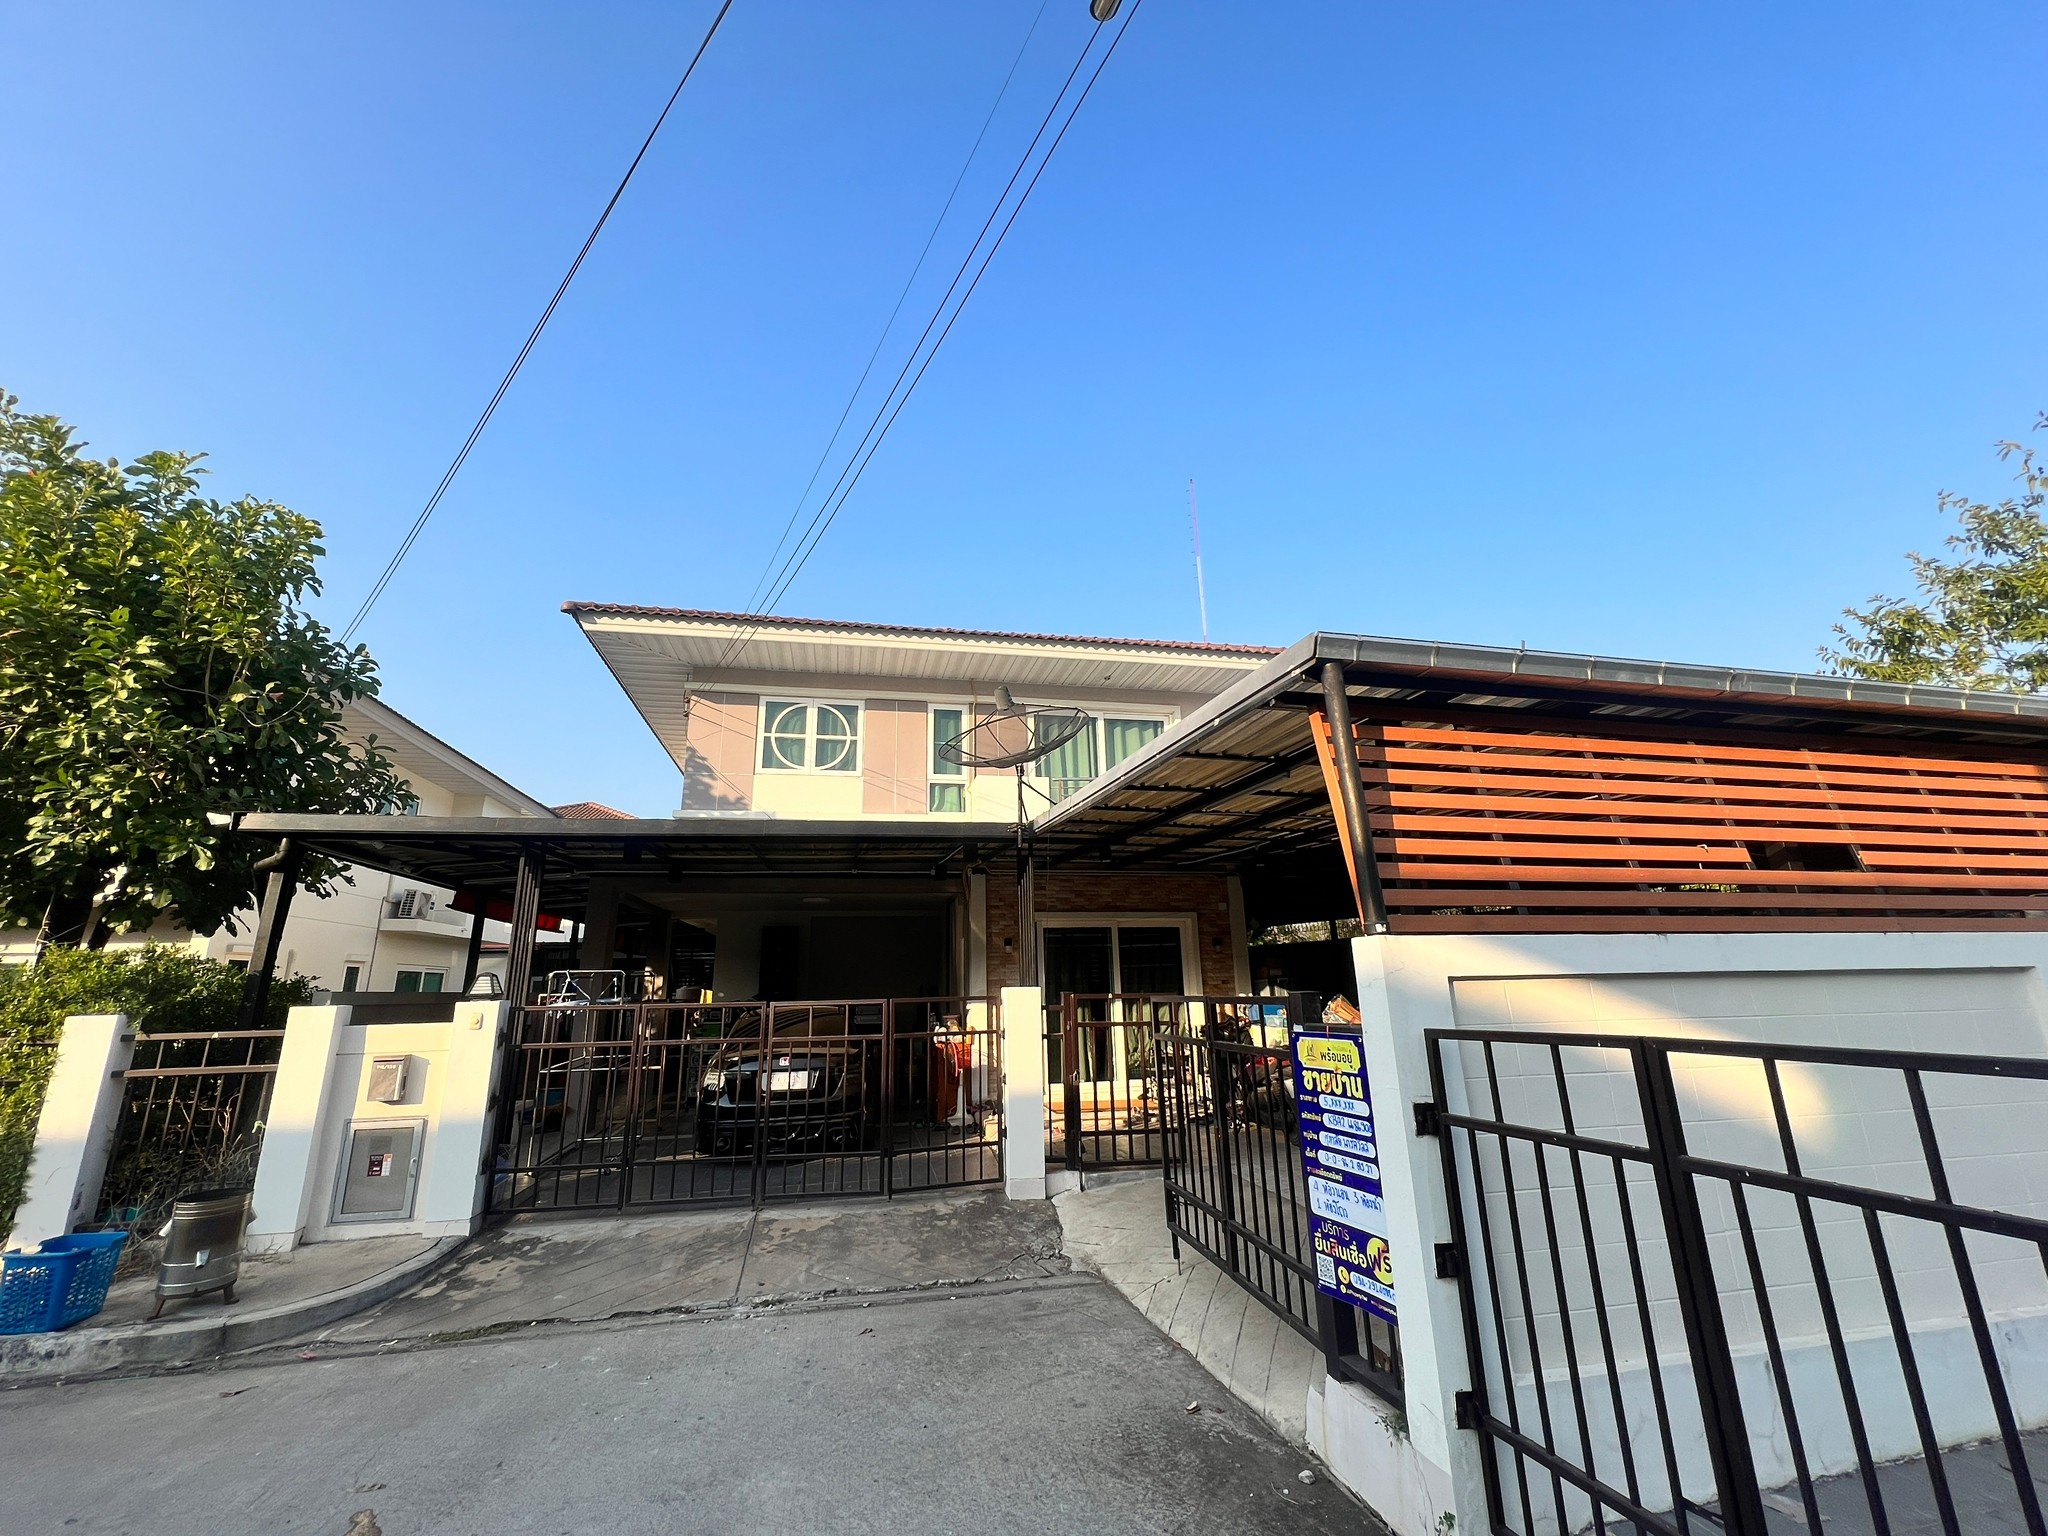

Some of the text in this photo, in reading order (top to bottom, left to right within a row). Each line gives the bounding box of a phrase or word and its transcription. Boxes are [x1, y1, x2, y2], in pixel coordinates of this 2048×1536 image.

[1320, 1046, 1353, 1069] พร้อมอยู่
[1321, 1220, 1350, 1241] บริการ
